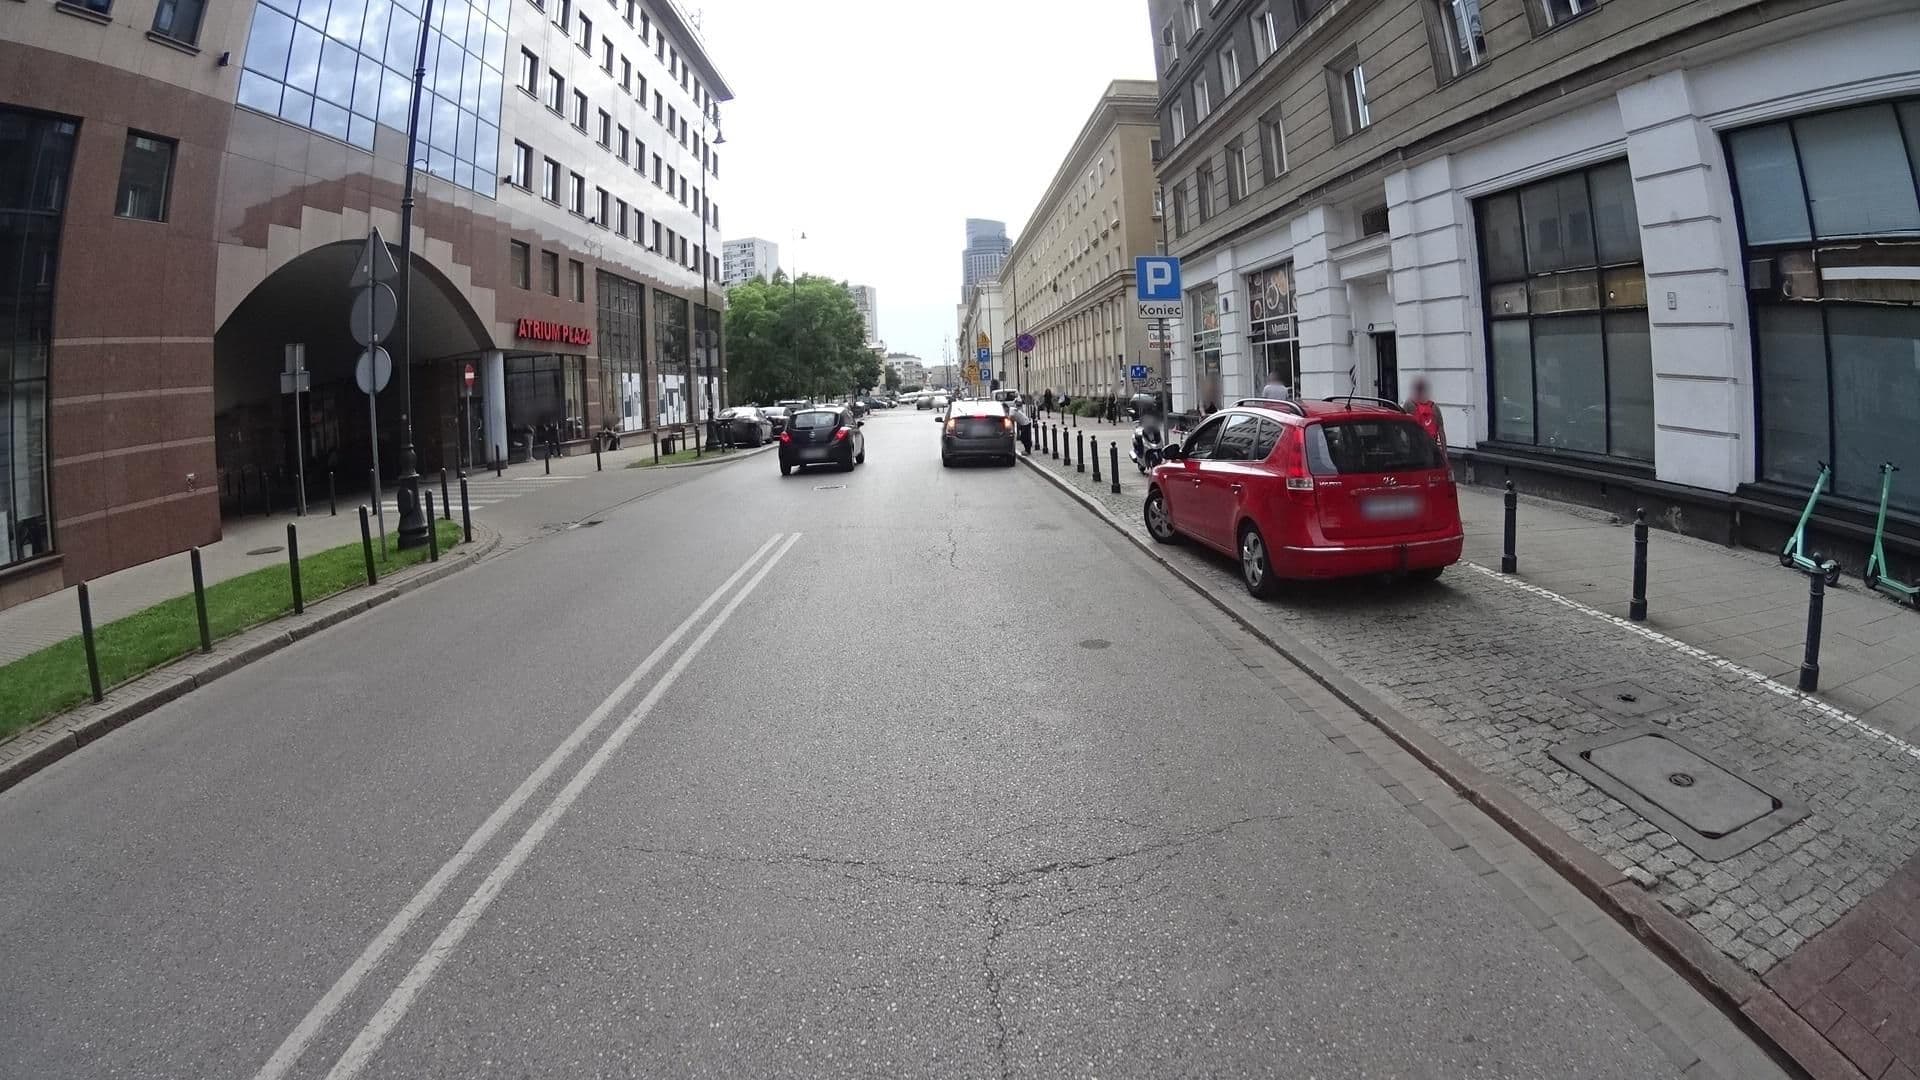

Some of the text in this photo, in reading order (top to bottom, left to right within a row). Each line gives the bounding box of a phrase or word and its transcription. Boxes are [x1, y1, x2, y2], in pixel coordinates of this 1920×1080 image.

[1145, 261, 1172, 294] P
[1139, 303, 1181, 316] Koniec
[518, 318, 592, 345] ATRIUM PLAZA
